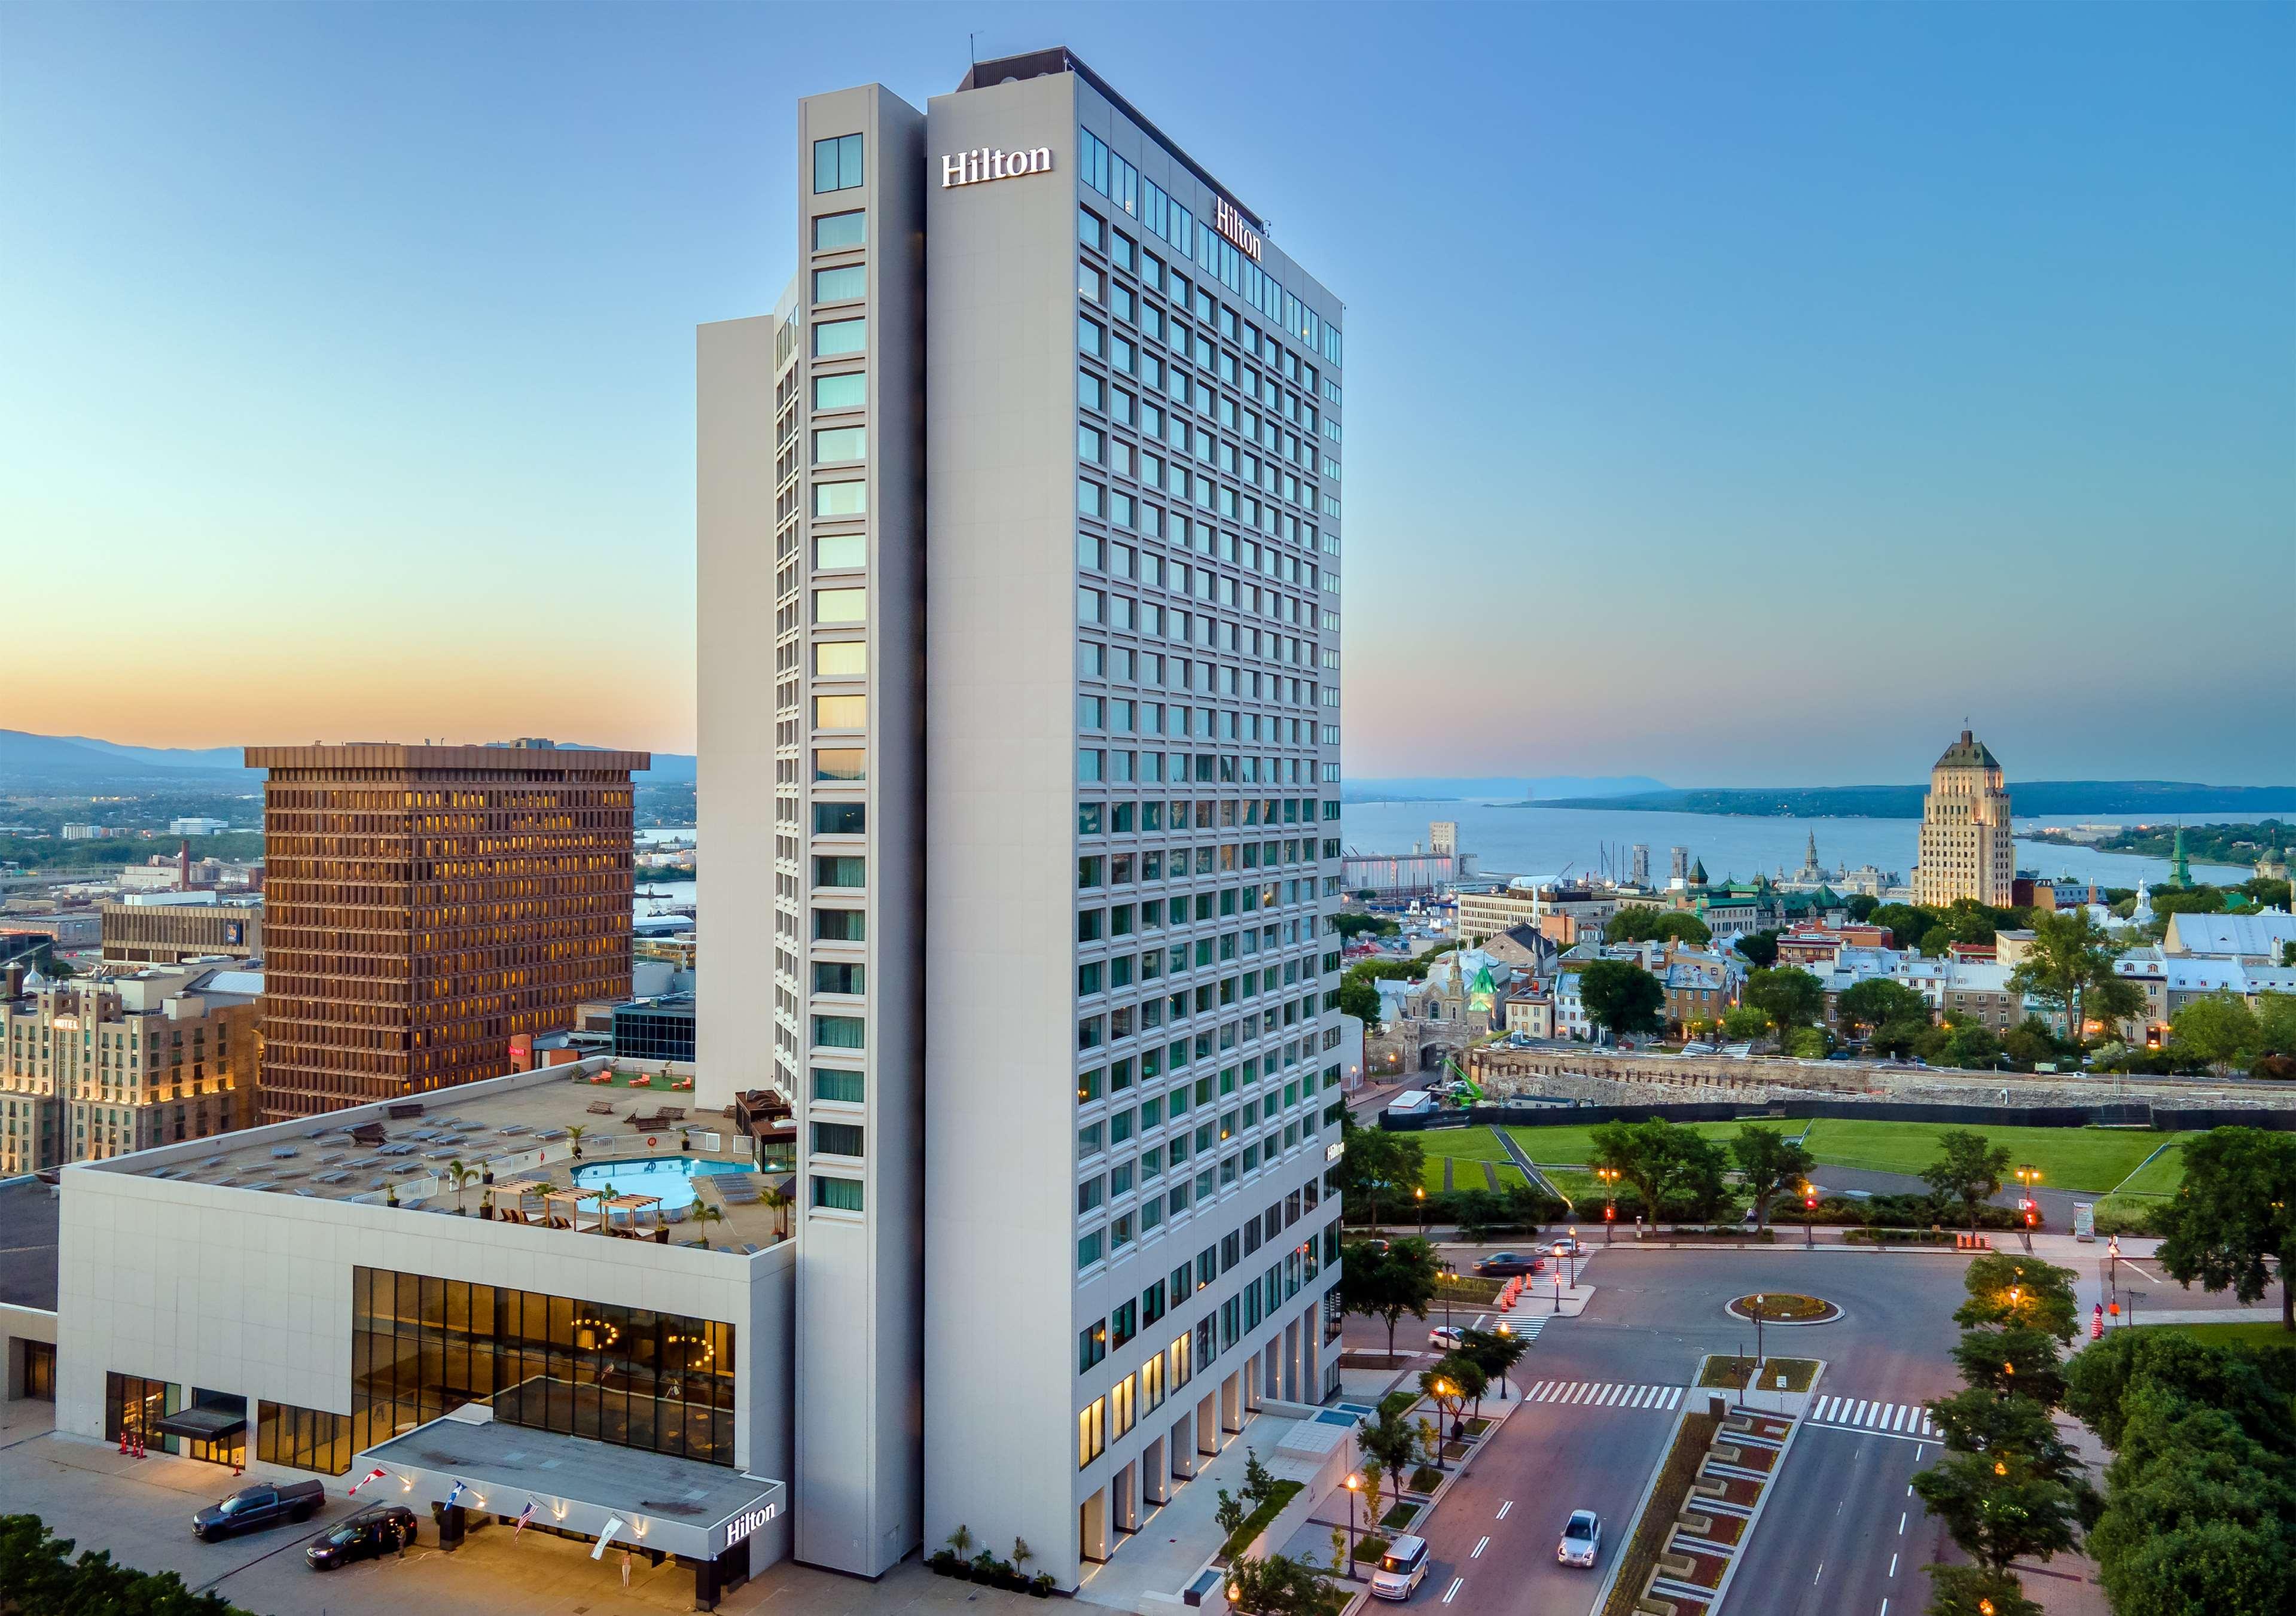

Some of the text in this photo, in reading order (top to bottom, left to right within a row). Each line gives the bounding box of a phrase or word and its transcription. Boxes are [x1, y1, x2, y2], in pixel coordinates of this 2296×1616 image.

[942, 147, 1051, 187] Hilton
[1216, 196, 1261, 262] Hilton
[1327, 1142, 1344, 1161] Hilton
[726, 1502, 775, 1547] Hilton
